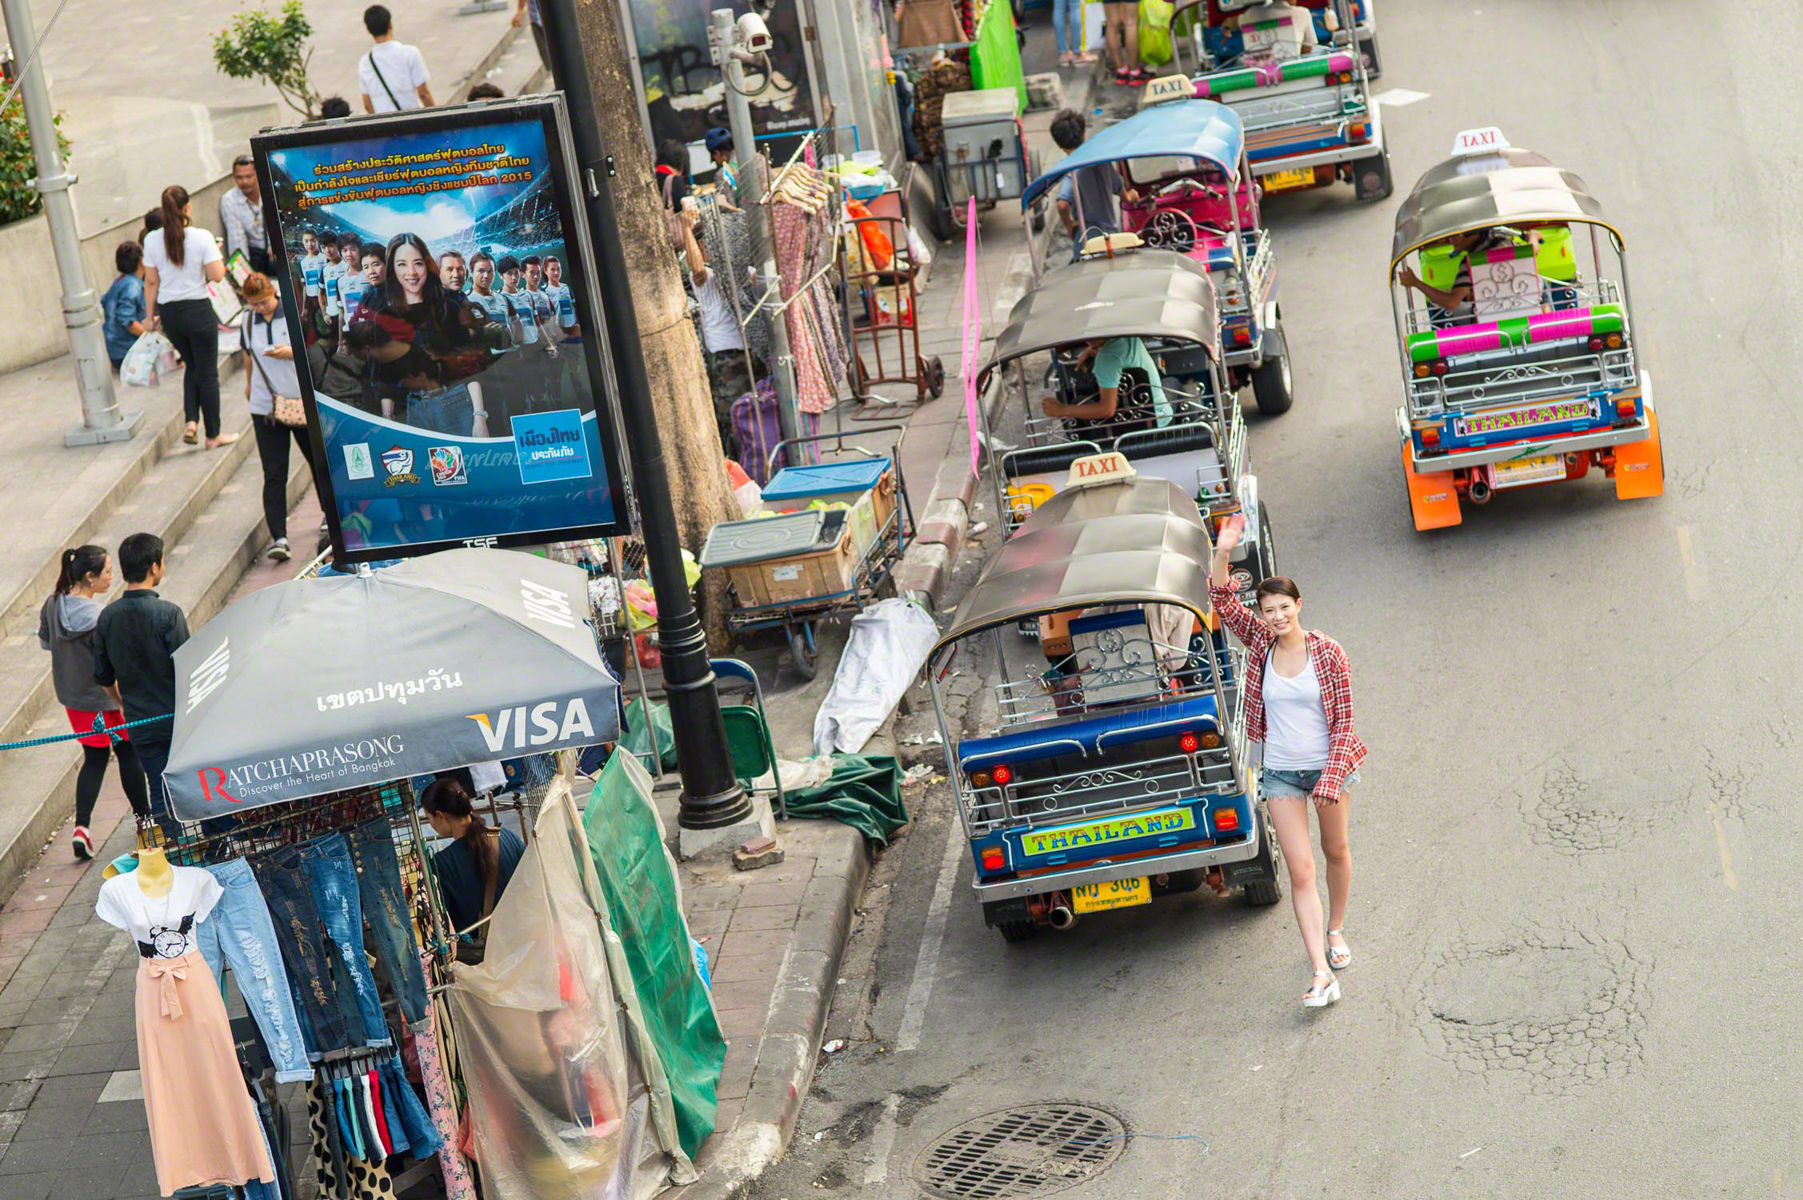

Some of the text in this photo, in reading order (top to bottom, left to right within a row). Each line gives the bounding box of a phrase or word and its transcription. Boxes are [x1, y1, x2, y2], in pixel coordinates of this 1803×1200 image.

[1152, 79, 1182, 95] TAXI
[1461, 131, 1495, 147] TAXI
[314, 144, 505, 175] ร่วมสร้างประวัติศาสตร์ฟุตบอลไทย
[501, 171, 532, 183] 2015
[1467, 403, 1588, 432] THAILAND
[519, 427, 580, 447] เมืองไทย
[1075, 456, 1119, 477] TAXI
[520, 578, 576, 629] VISA
[186, 635, 231, 715] VISA
[316, 667, 463, 711] เขตปทุมวัน
[465, 697, 595, 752] VISA
[197, 734, 404, 803] RATCHAPRASONG
[239, 757, 396, 798] Discover the Heart of Bangkok
[1031, 812, 1184, 851] THAILAND
